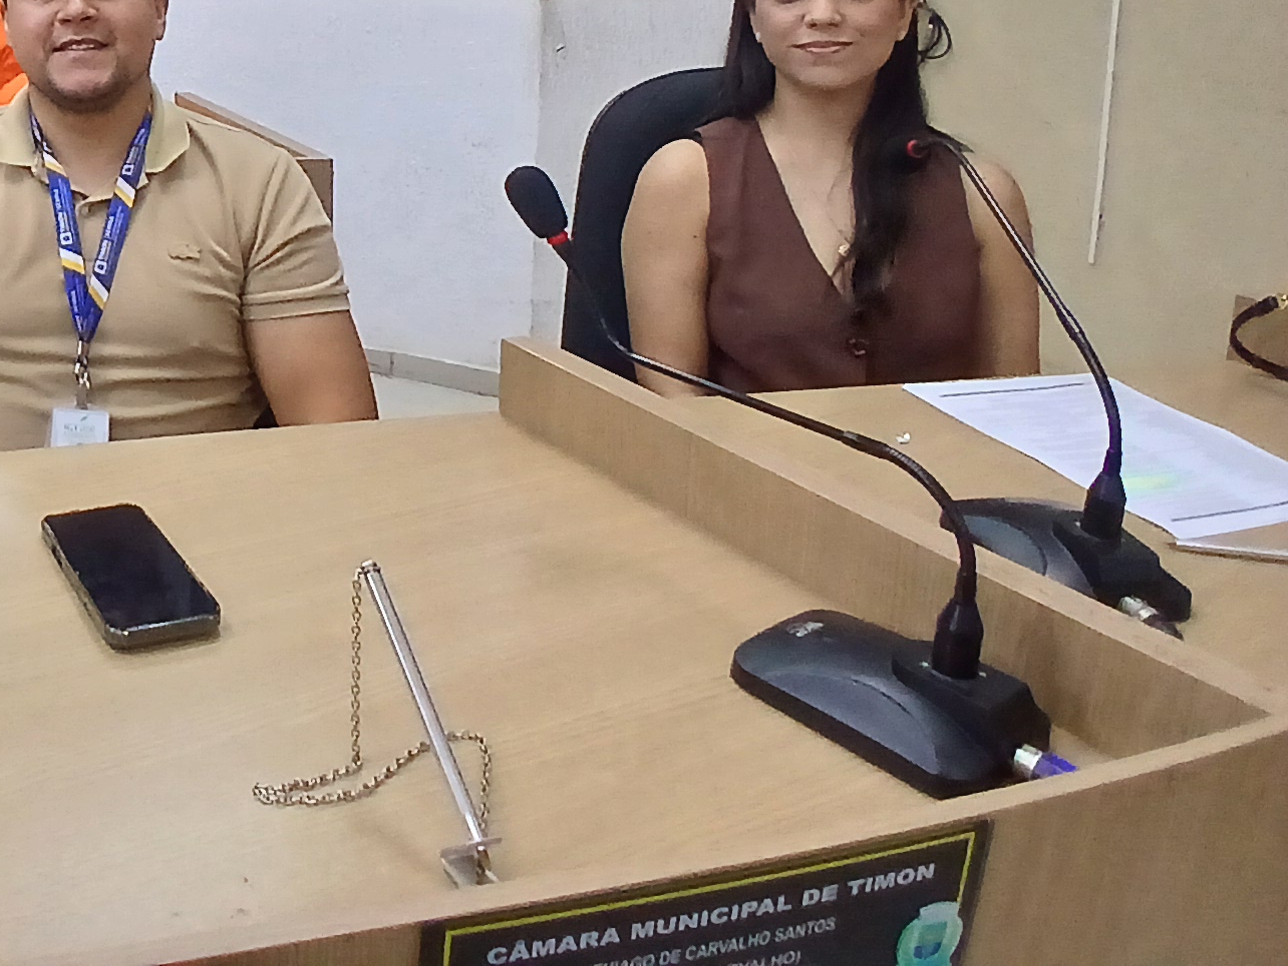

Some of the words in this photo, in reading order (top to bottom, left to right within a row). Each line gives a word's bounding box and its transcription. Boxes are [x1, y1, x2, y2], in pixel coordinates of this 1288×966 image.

[486, 927, 620, 965] CÂMARA
[631, 895, 792, 940] MUNICIPAL
[802, 884, 839, 907] DE
[847, 863, 935, 896] TIMON
[659, 948, 681, 966] DE
[685, 930, 771, 961] CARVALHO
[775, 917, 836, 943] SANTOS
